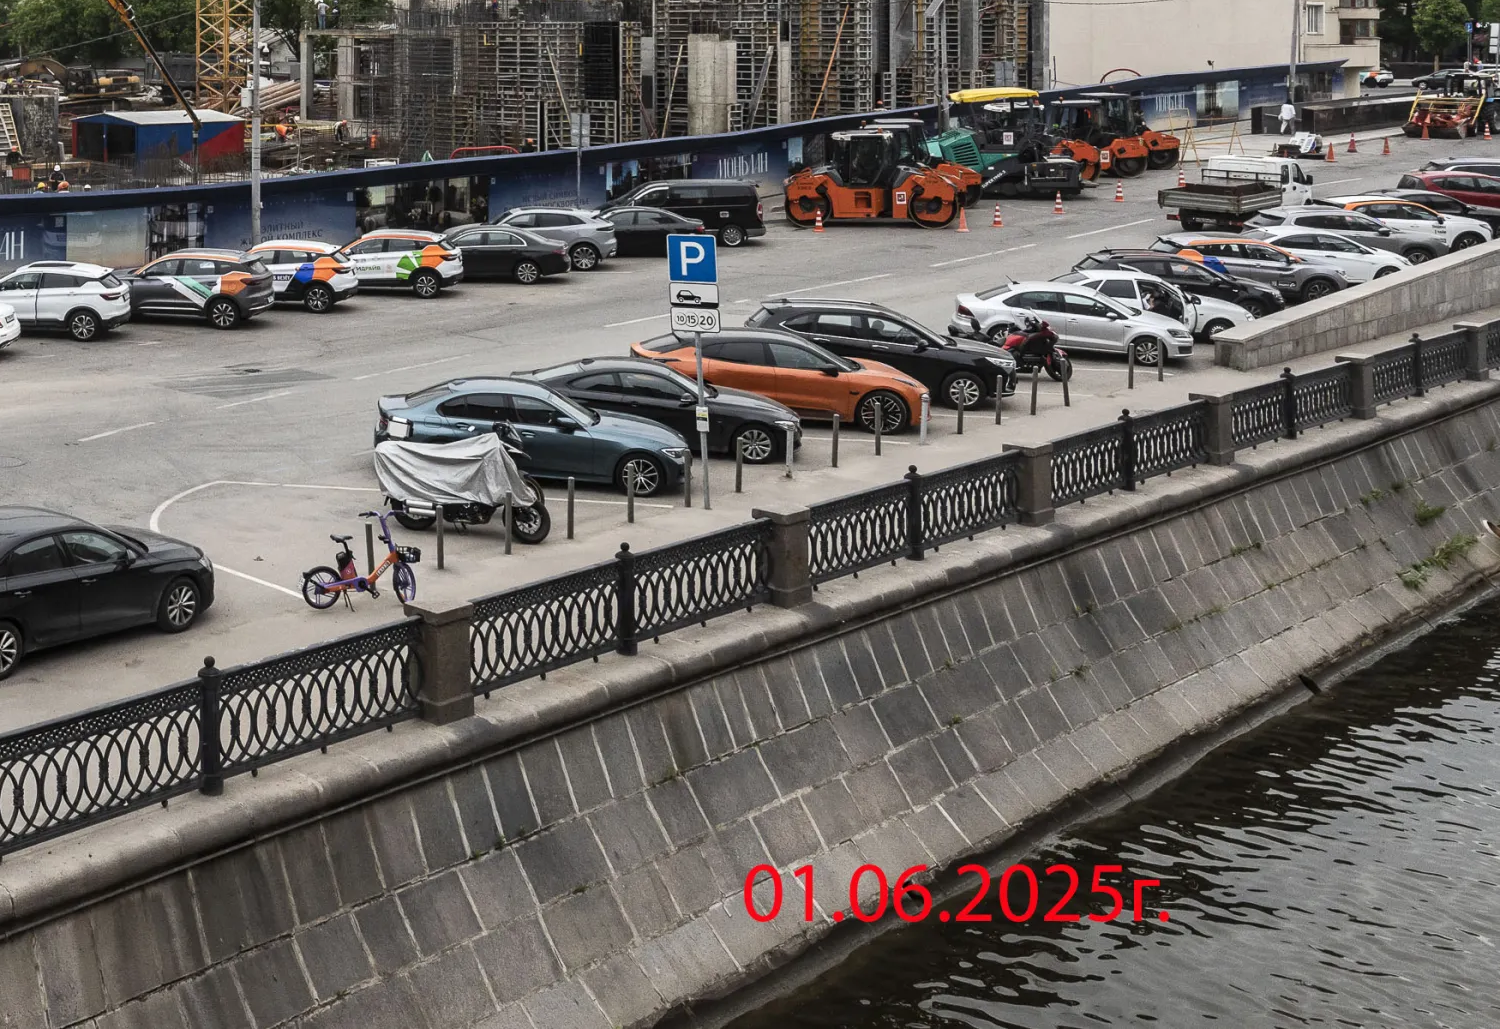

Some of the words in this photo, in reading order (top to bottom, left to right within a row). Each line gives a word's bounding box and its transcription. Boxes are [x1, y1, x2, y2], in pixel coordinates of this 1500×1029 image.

[261, 221, 304, 233] ЭЛИТНЫЙ
[680, 241, 705, 276] P
[687, 316, 696, 324] 15
[700, 316, 714, 326] 20
